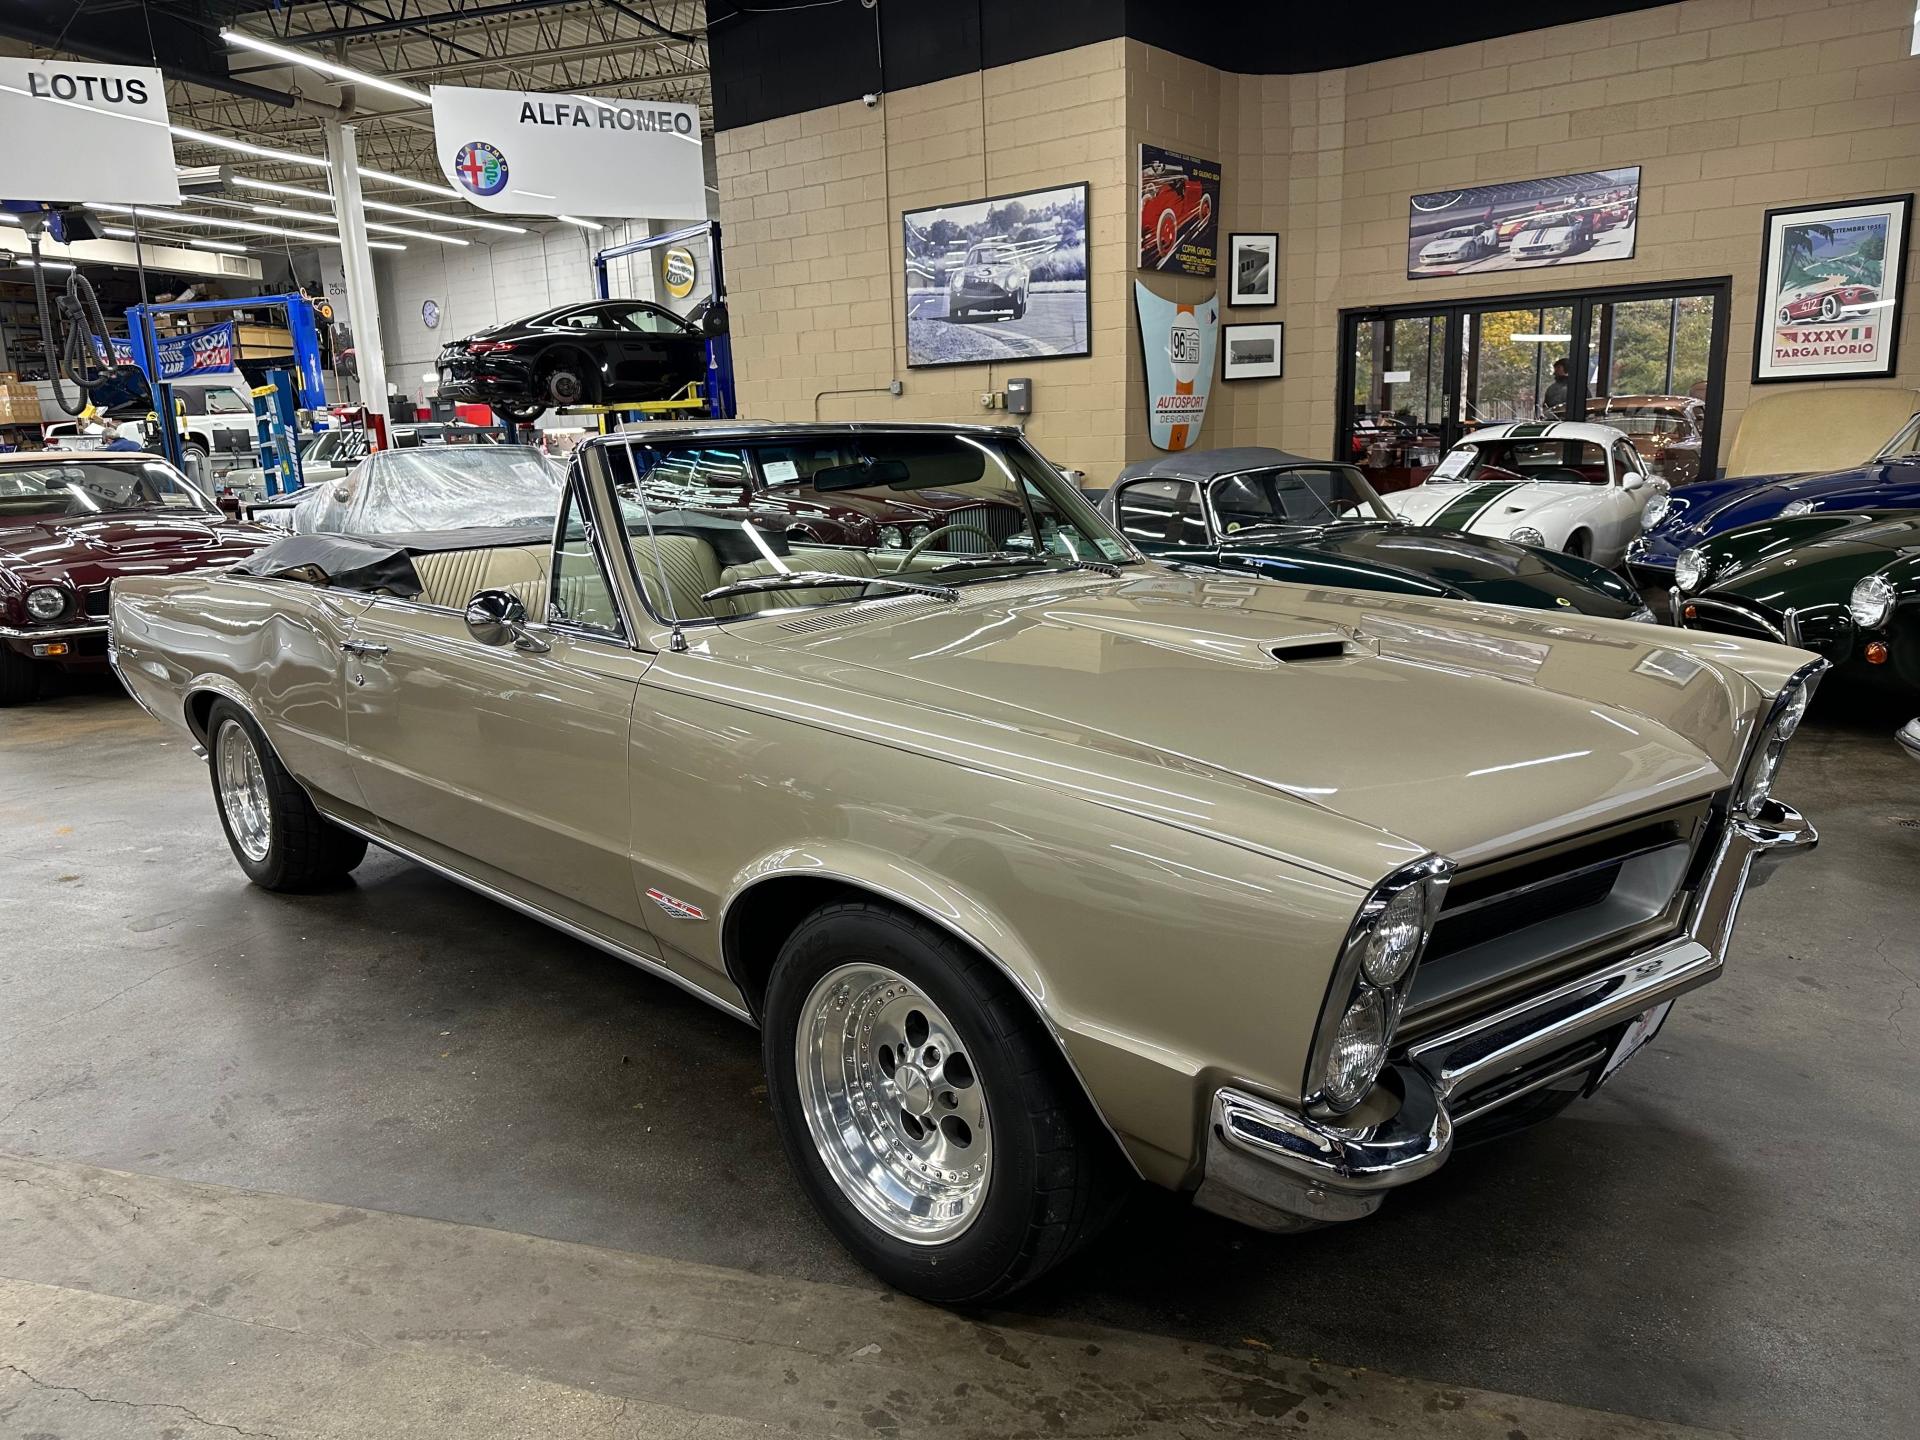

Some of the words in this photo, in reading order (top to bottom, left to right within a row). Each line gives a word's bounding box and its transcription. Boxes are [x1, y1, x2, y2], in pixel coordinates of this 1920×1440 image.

[28, 72, 149, 105] LOTUS
[519, 101, 591, 128] ALFA
[597, 106, 693, 135] ROMEO
[476, 142, 508, 172] ROMEO
[1830, 224, 1866, 235] ETTEMBRE
[1801, 300, 1818, 312] 472
[192, 331, 229, 352] LIQUI
[1801, 328, 1849, 344] XXXV
[1173, 332, 1186, 359] 96
[1775, 346, 1820, 359] TARGA
[1823, 343, 1875, 356] FLORIO
[164, 361, 185, 374] CARE
[1157, 396, 1205, 409] AUTOSPORT
[1160, 414, 1190, 424] DESIGNS
